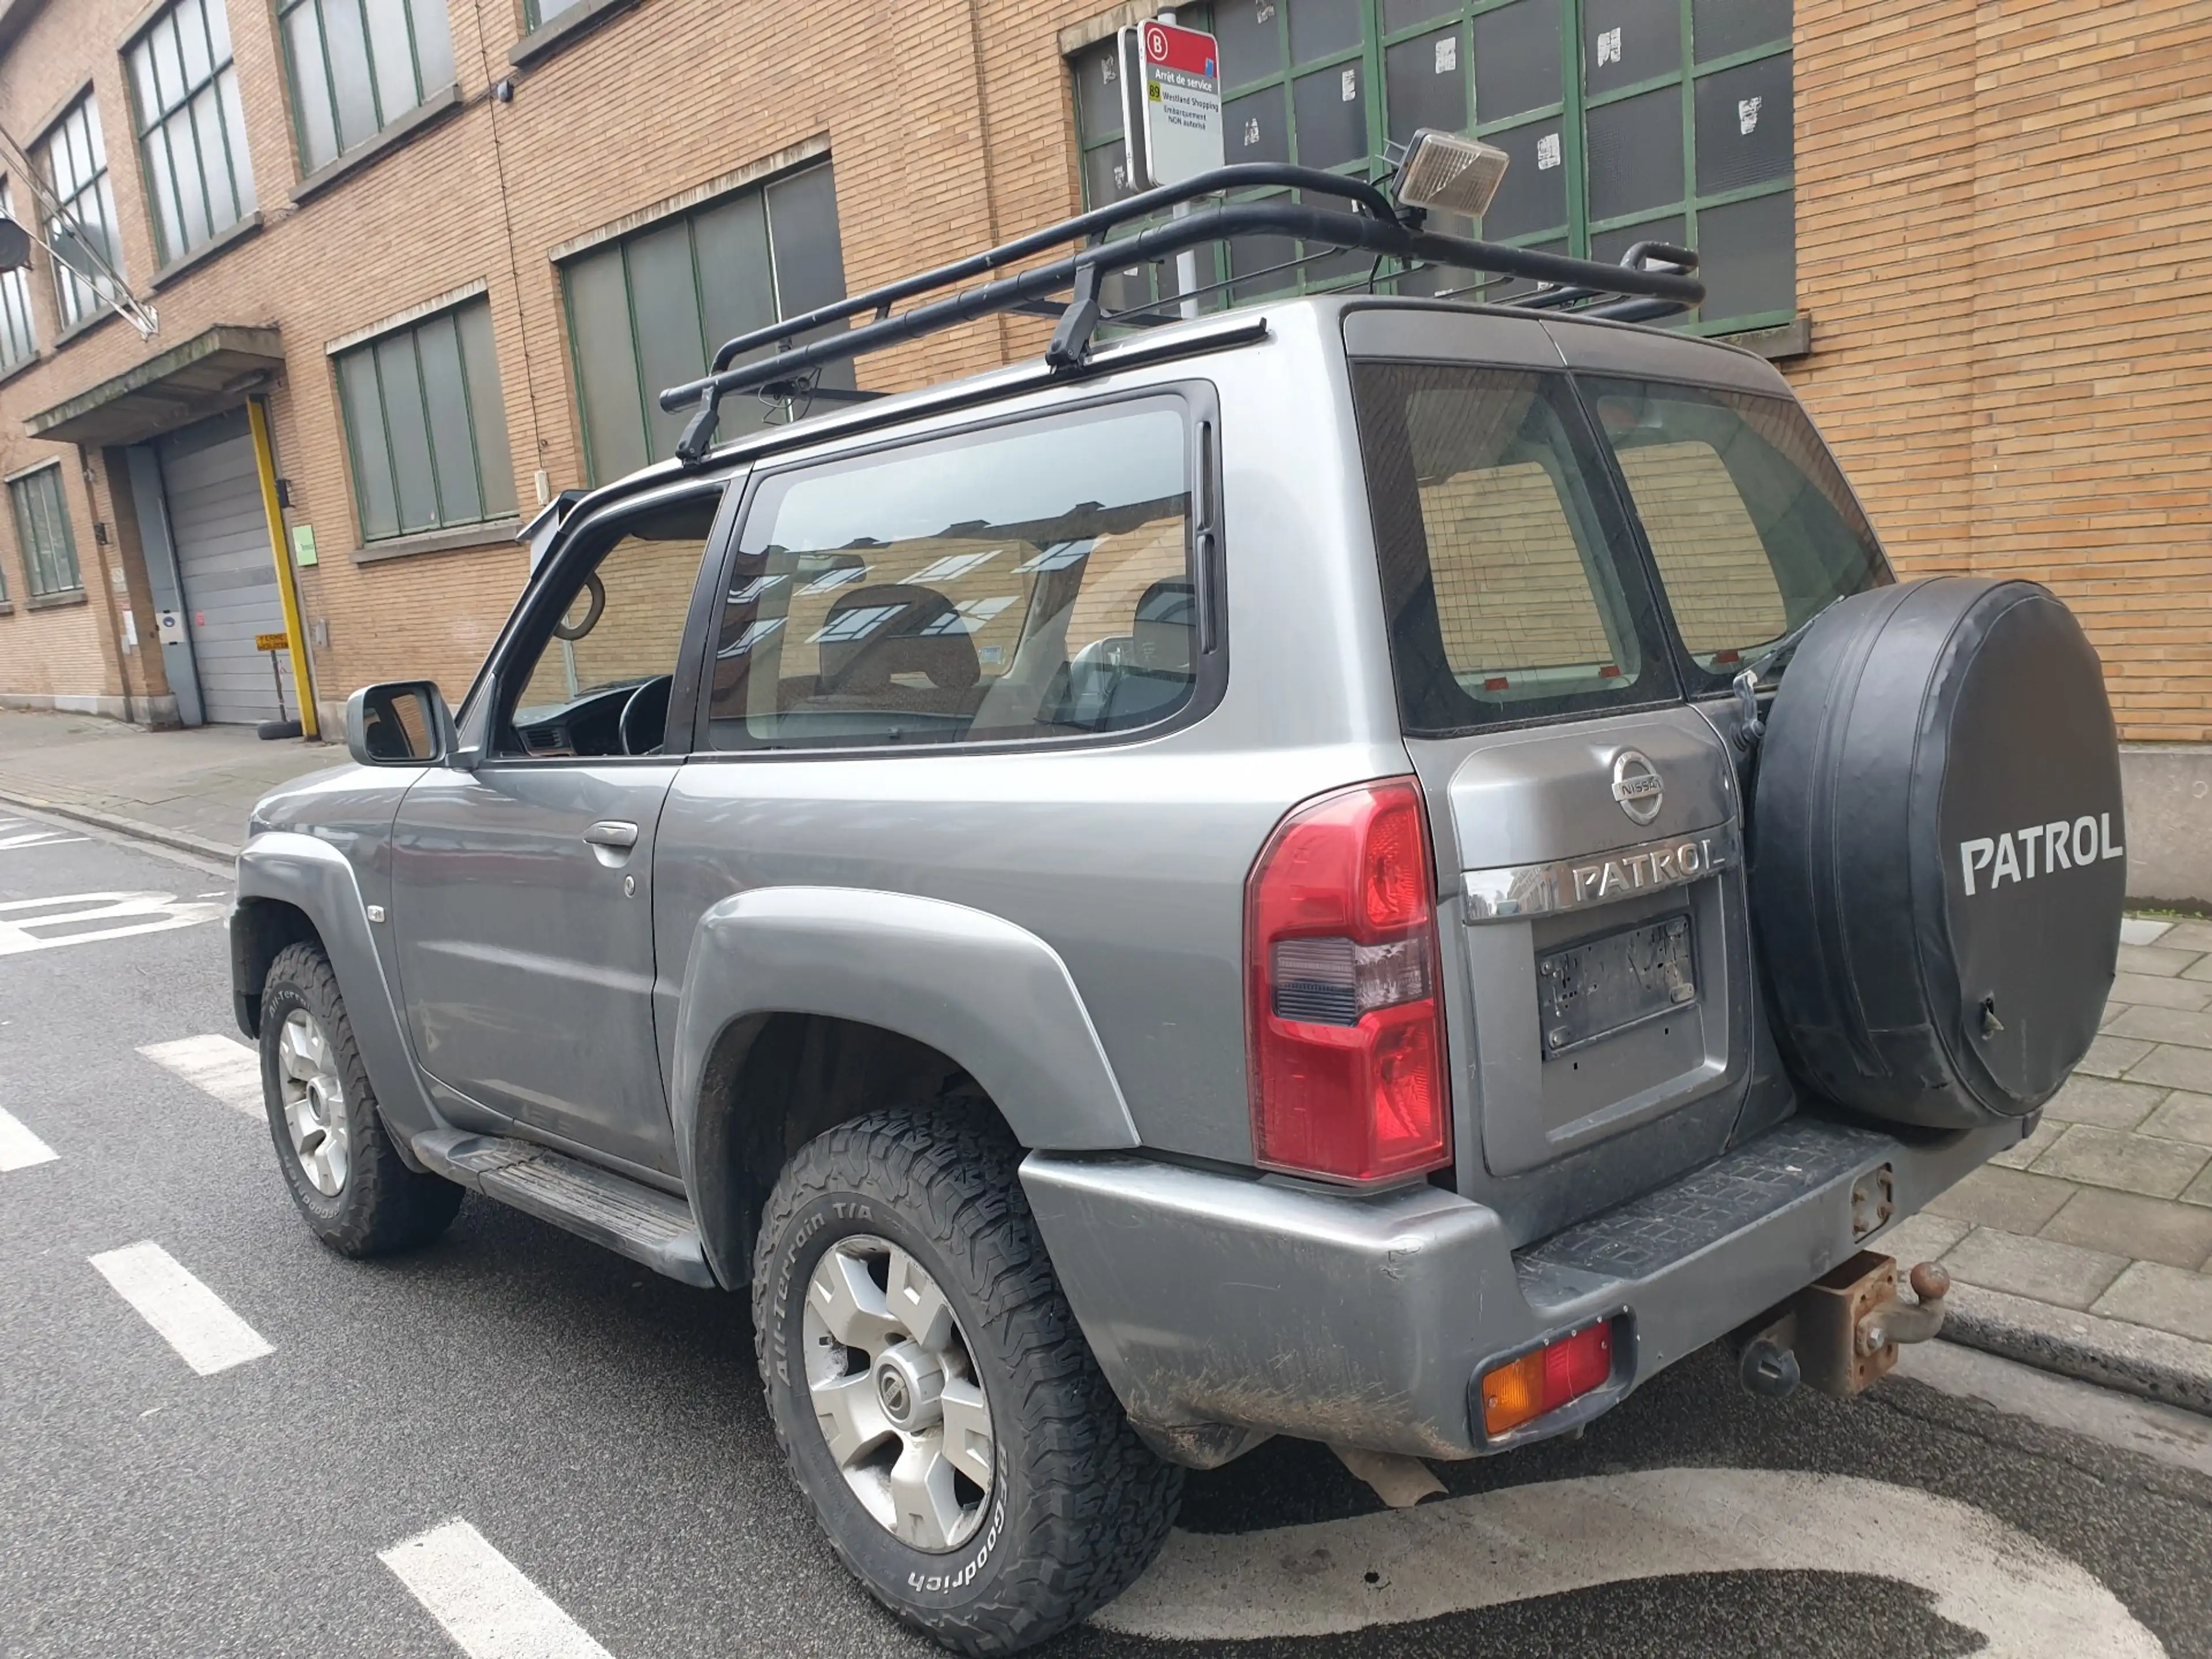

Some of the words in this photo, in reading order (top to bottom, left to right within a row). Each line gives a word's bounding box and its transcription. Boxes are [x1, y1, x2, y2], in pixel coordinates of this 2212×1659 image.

[1153, 34, 1162, 53] B
[1149, 85, 1160, 97] 89
[1156, 68, 1175, 83] Arrêt
[1176, 74, 1185, 85] de
[1187, 78, 1212, 92] service
[1162, 92, 1190, 104] Westland
[1191, 97, 1218, 112] Shopping
[1573, 839, 1725, 902] PATROL
[1961, 812, 2123, 896] PATROL
[774, 1213, 825, 1387] All-Terrain
[833, 1202, 876, 1222] T/A
[908, 1443, 1008, 1594] BFGoodrich
